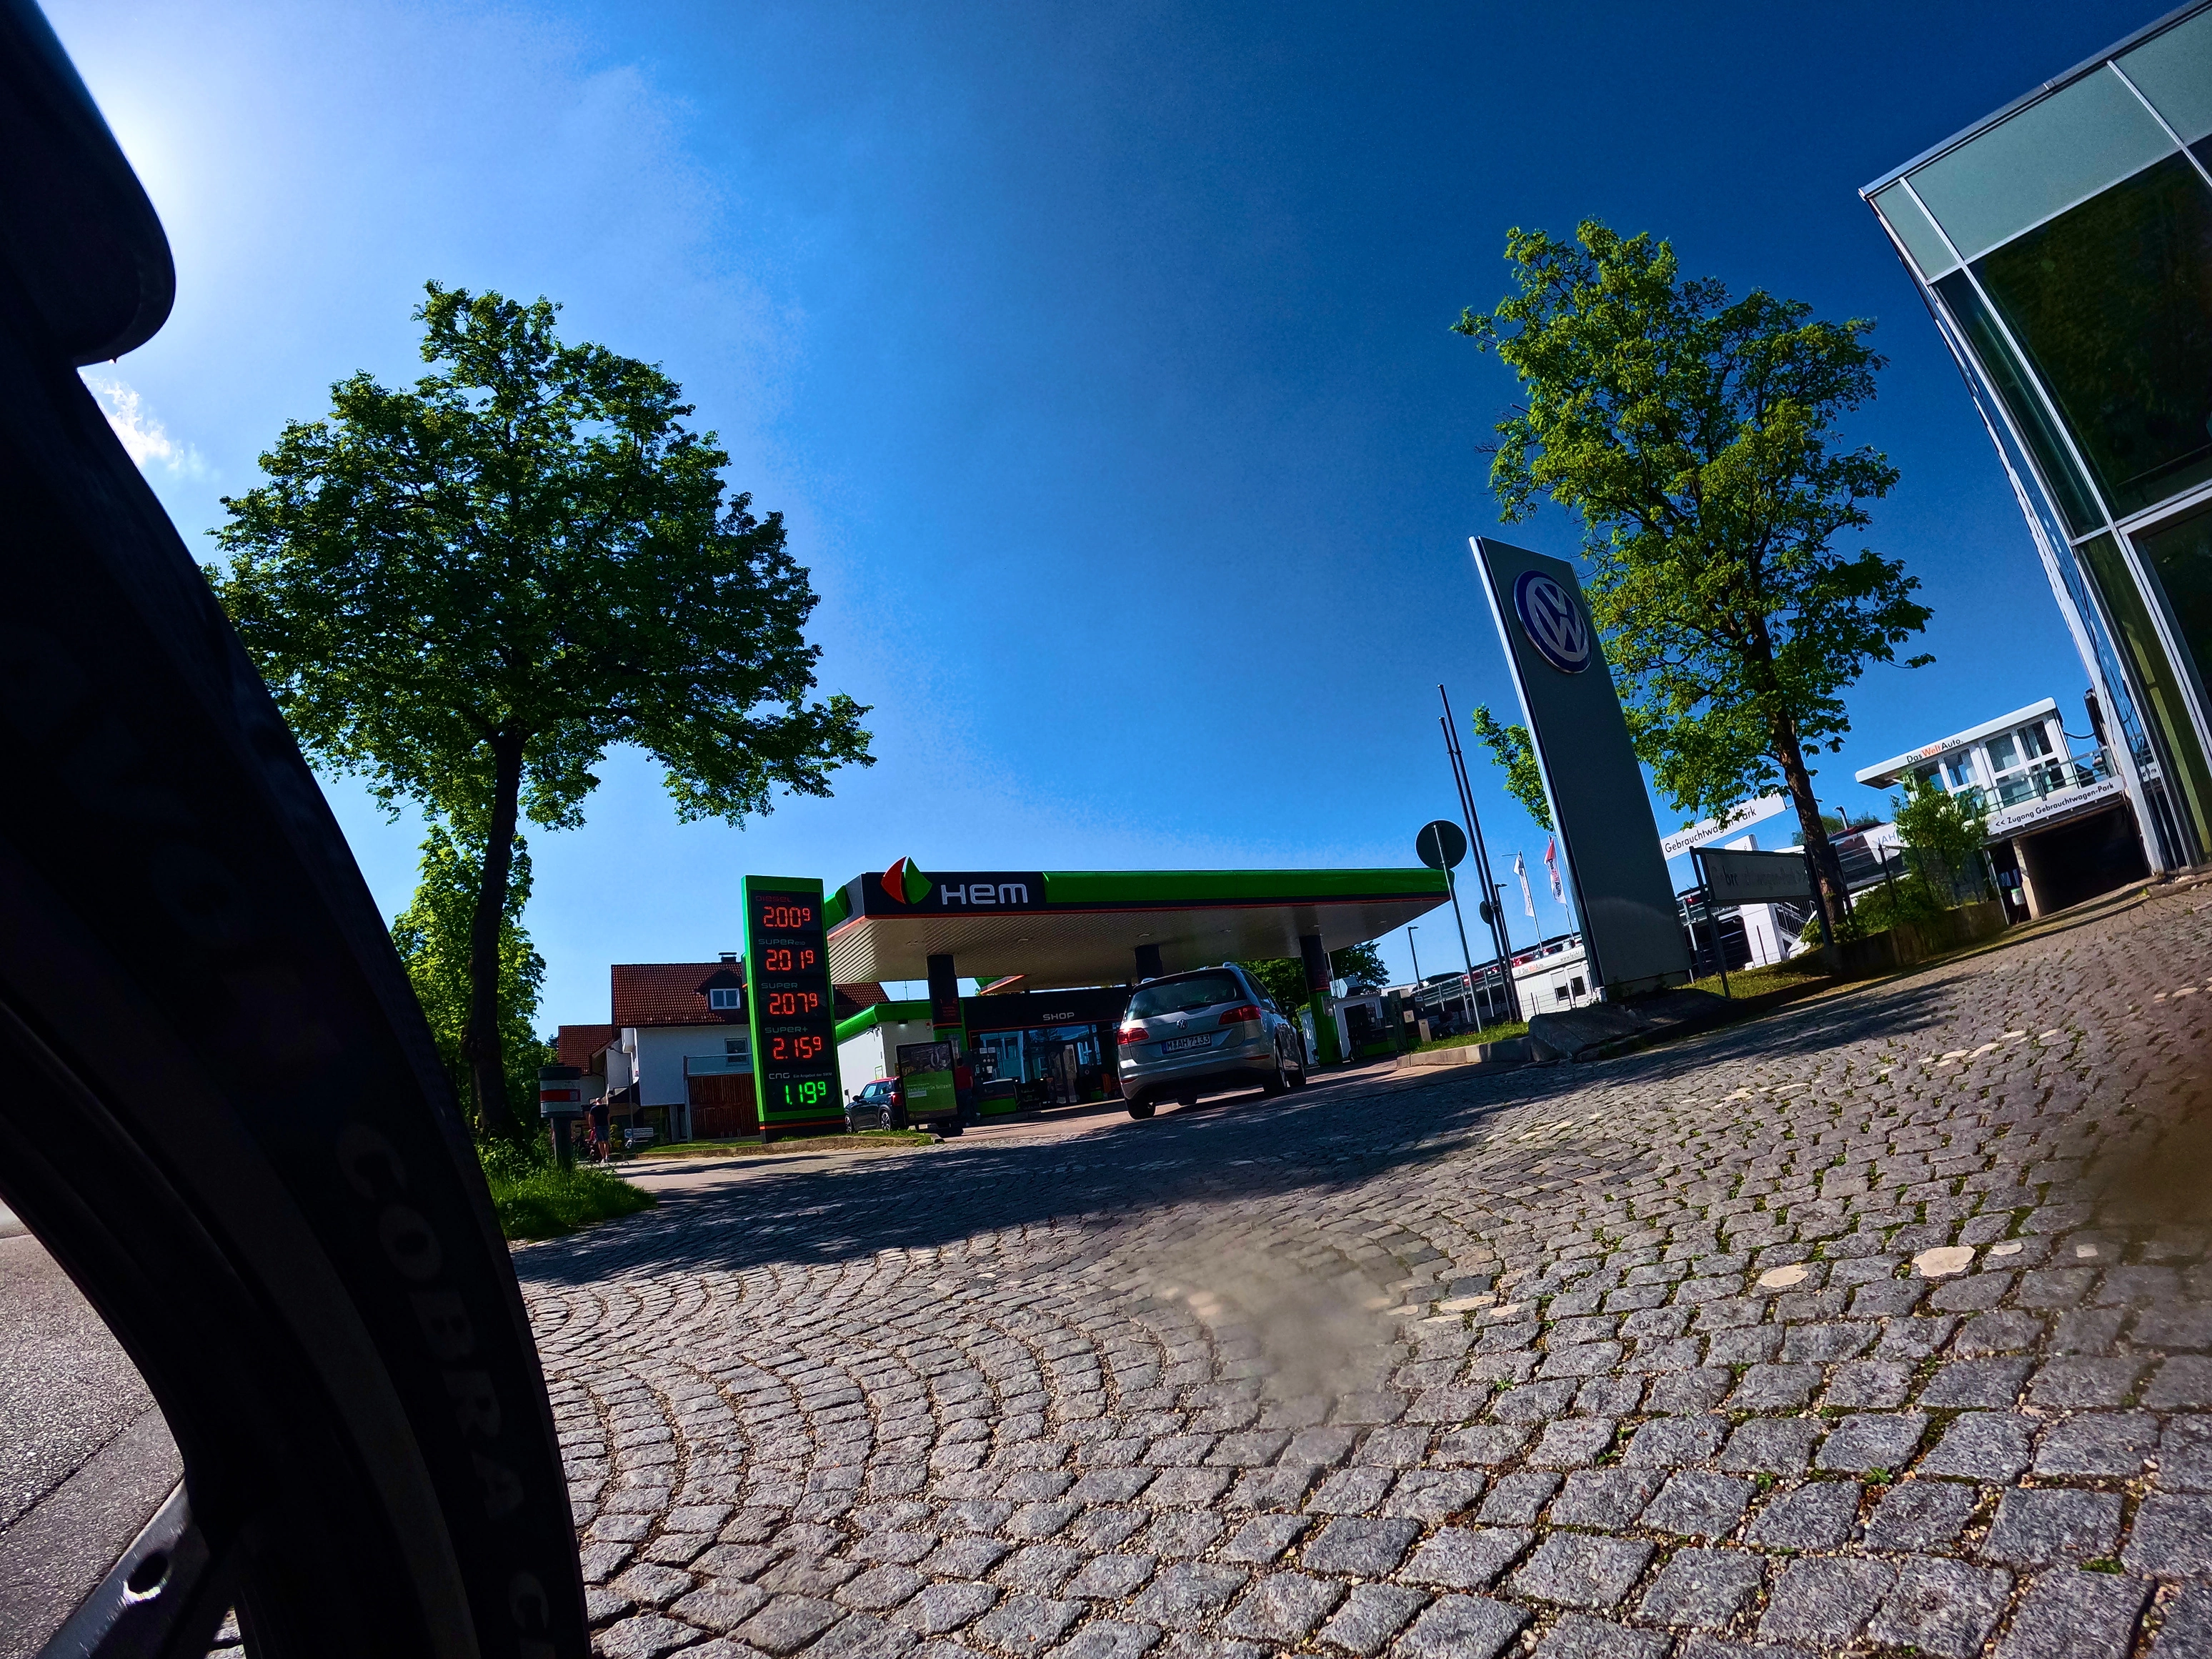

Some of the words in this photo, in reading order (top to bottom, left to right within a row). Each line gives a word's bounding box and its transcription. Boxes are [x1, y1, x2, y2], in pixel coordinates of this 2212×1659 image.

[2007, 811, 2035, 824] Zugang
[2036, 782, 2114, 814] Gebrauchtwagen-Park
[762, 906, 812, 928] 2.009
[765, 949, 815, 971] 2.019
[769, 992, 819, 1015] 2.079
[1042, 1012, 1075, 1021] SHOP
[772, 1036, 823, 1060] 2.159
[784, 1080, 827, 1105] 1.199
